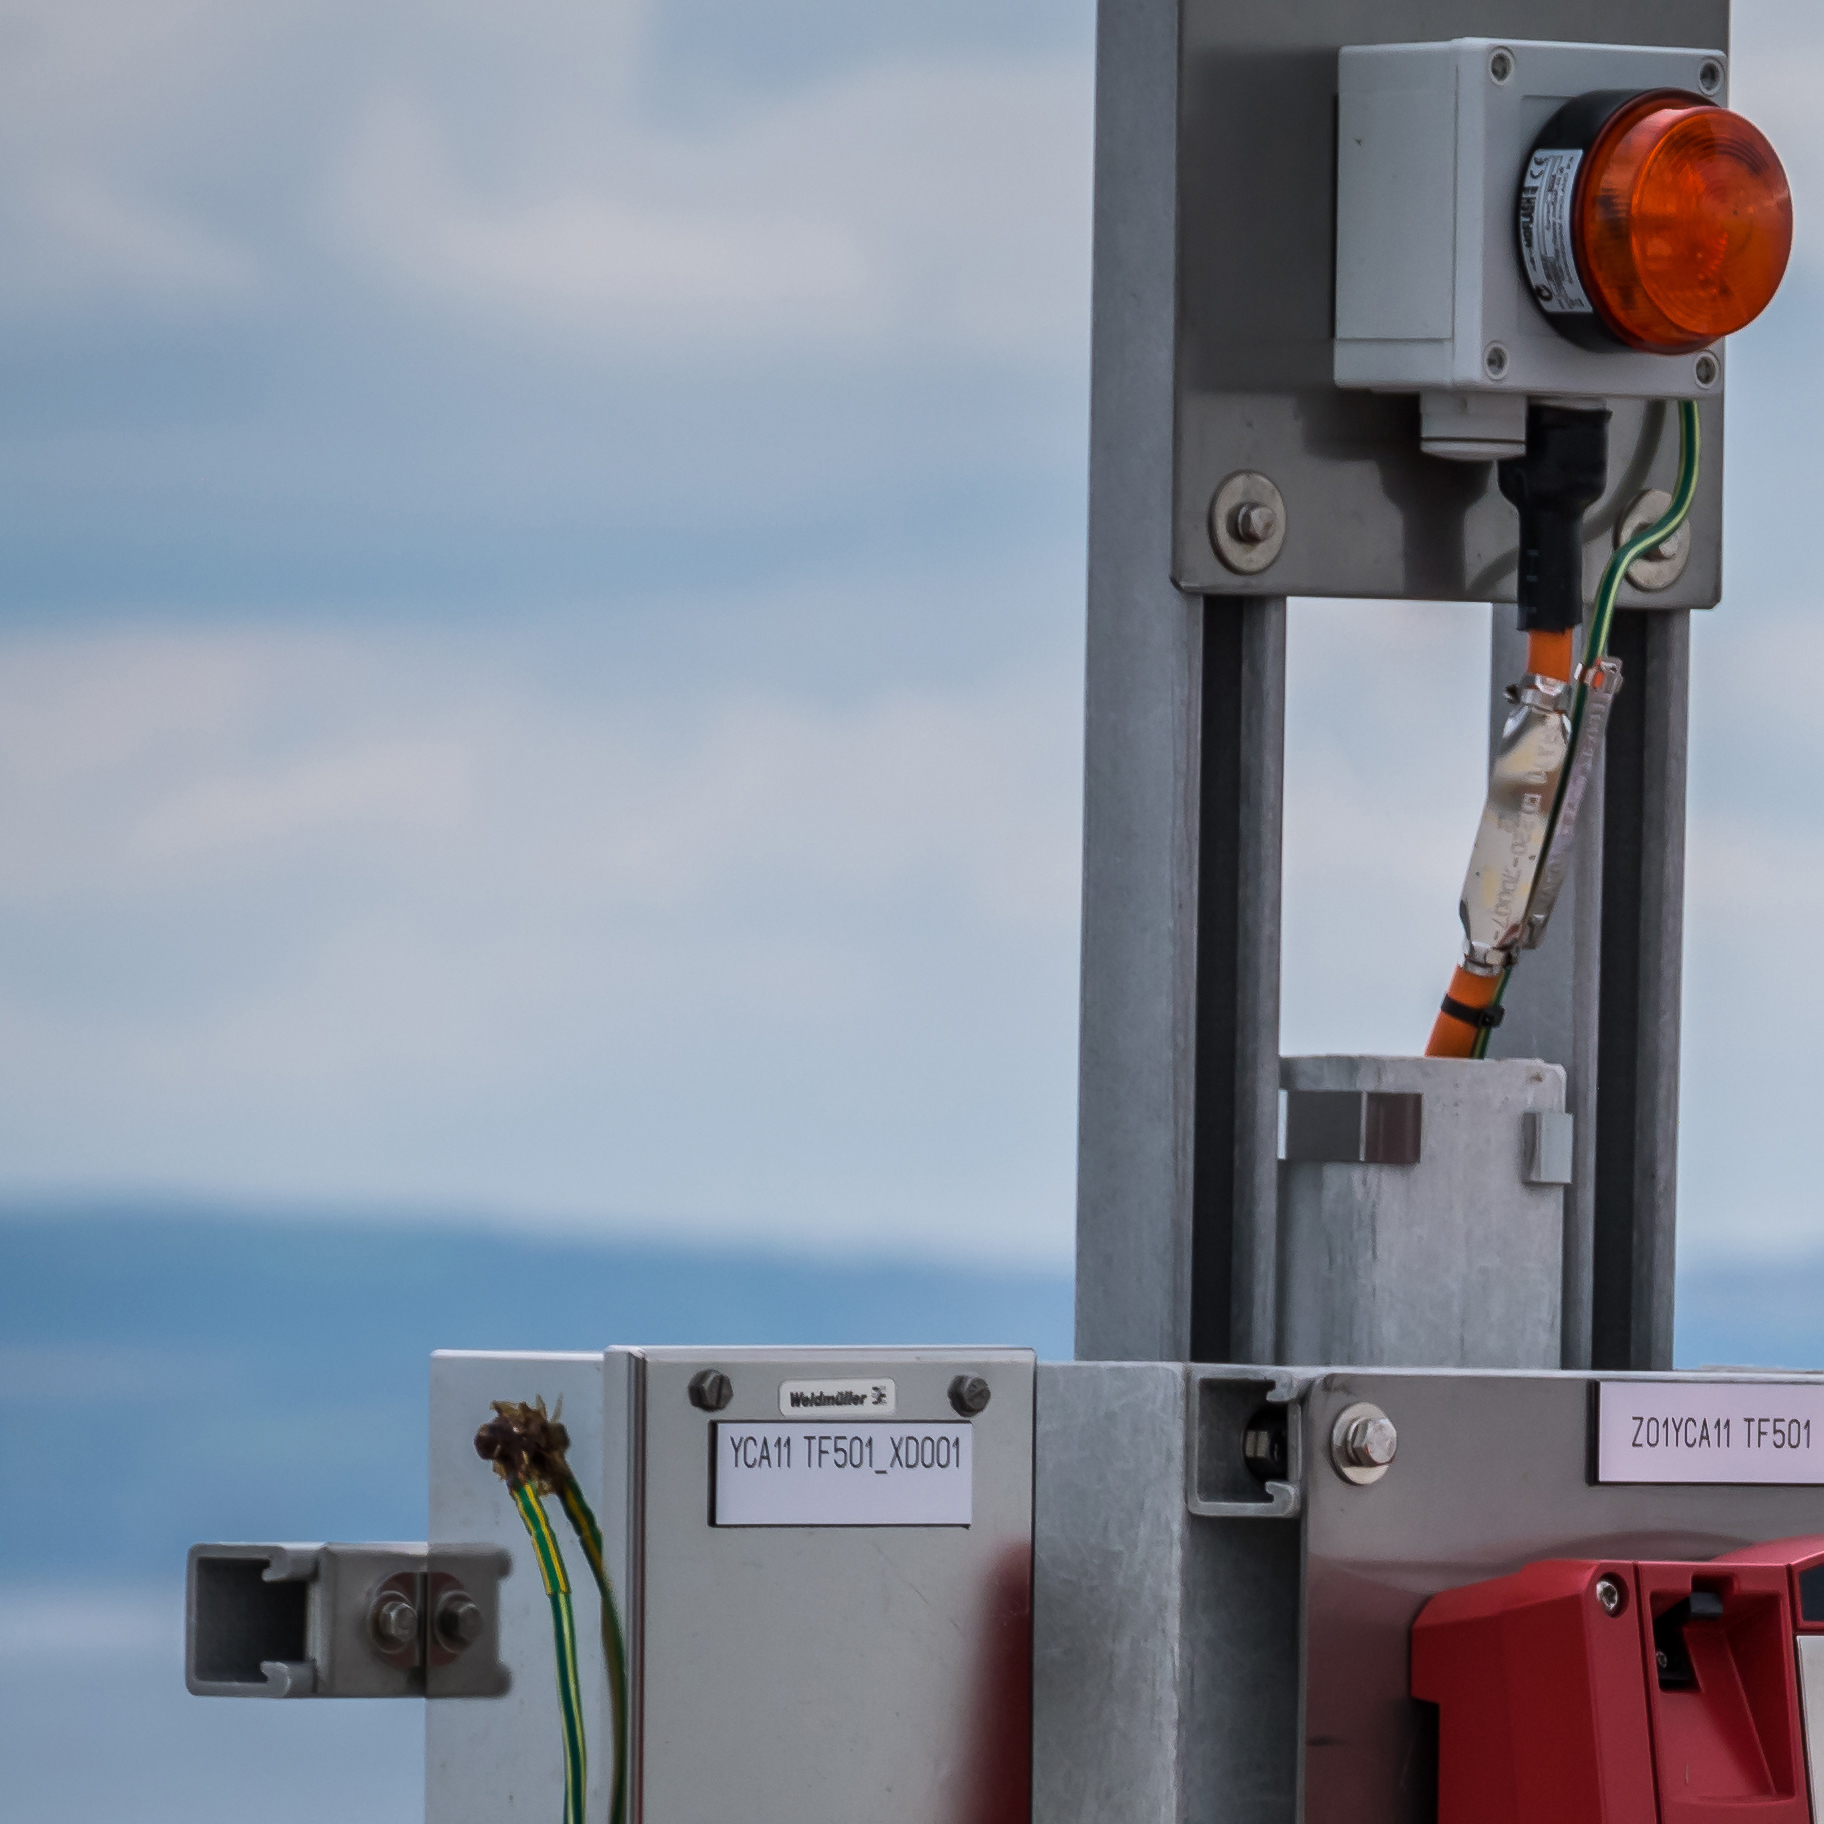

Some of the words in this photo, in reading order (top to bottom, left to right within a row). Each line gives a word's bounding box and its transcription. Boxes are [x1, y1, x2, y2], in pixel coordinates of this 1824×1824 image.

[1631, 1416, 1731, 1447] Z01YCA11
[1743, 1417, 1811, 1449] TF501
[730, 1435, 791, 1469] YCA11
[803, 1435, 960, 1475] TF501_XD001
